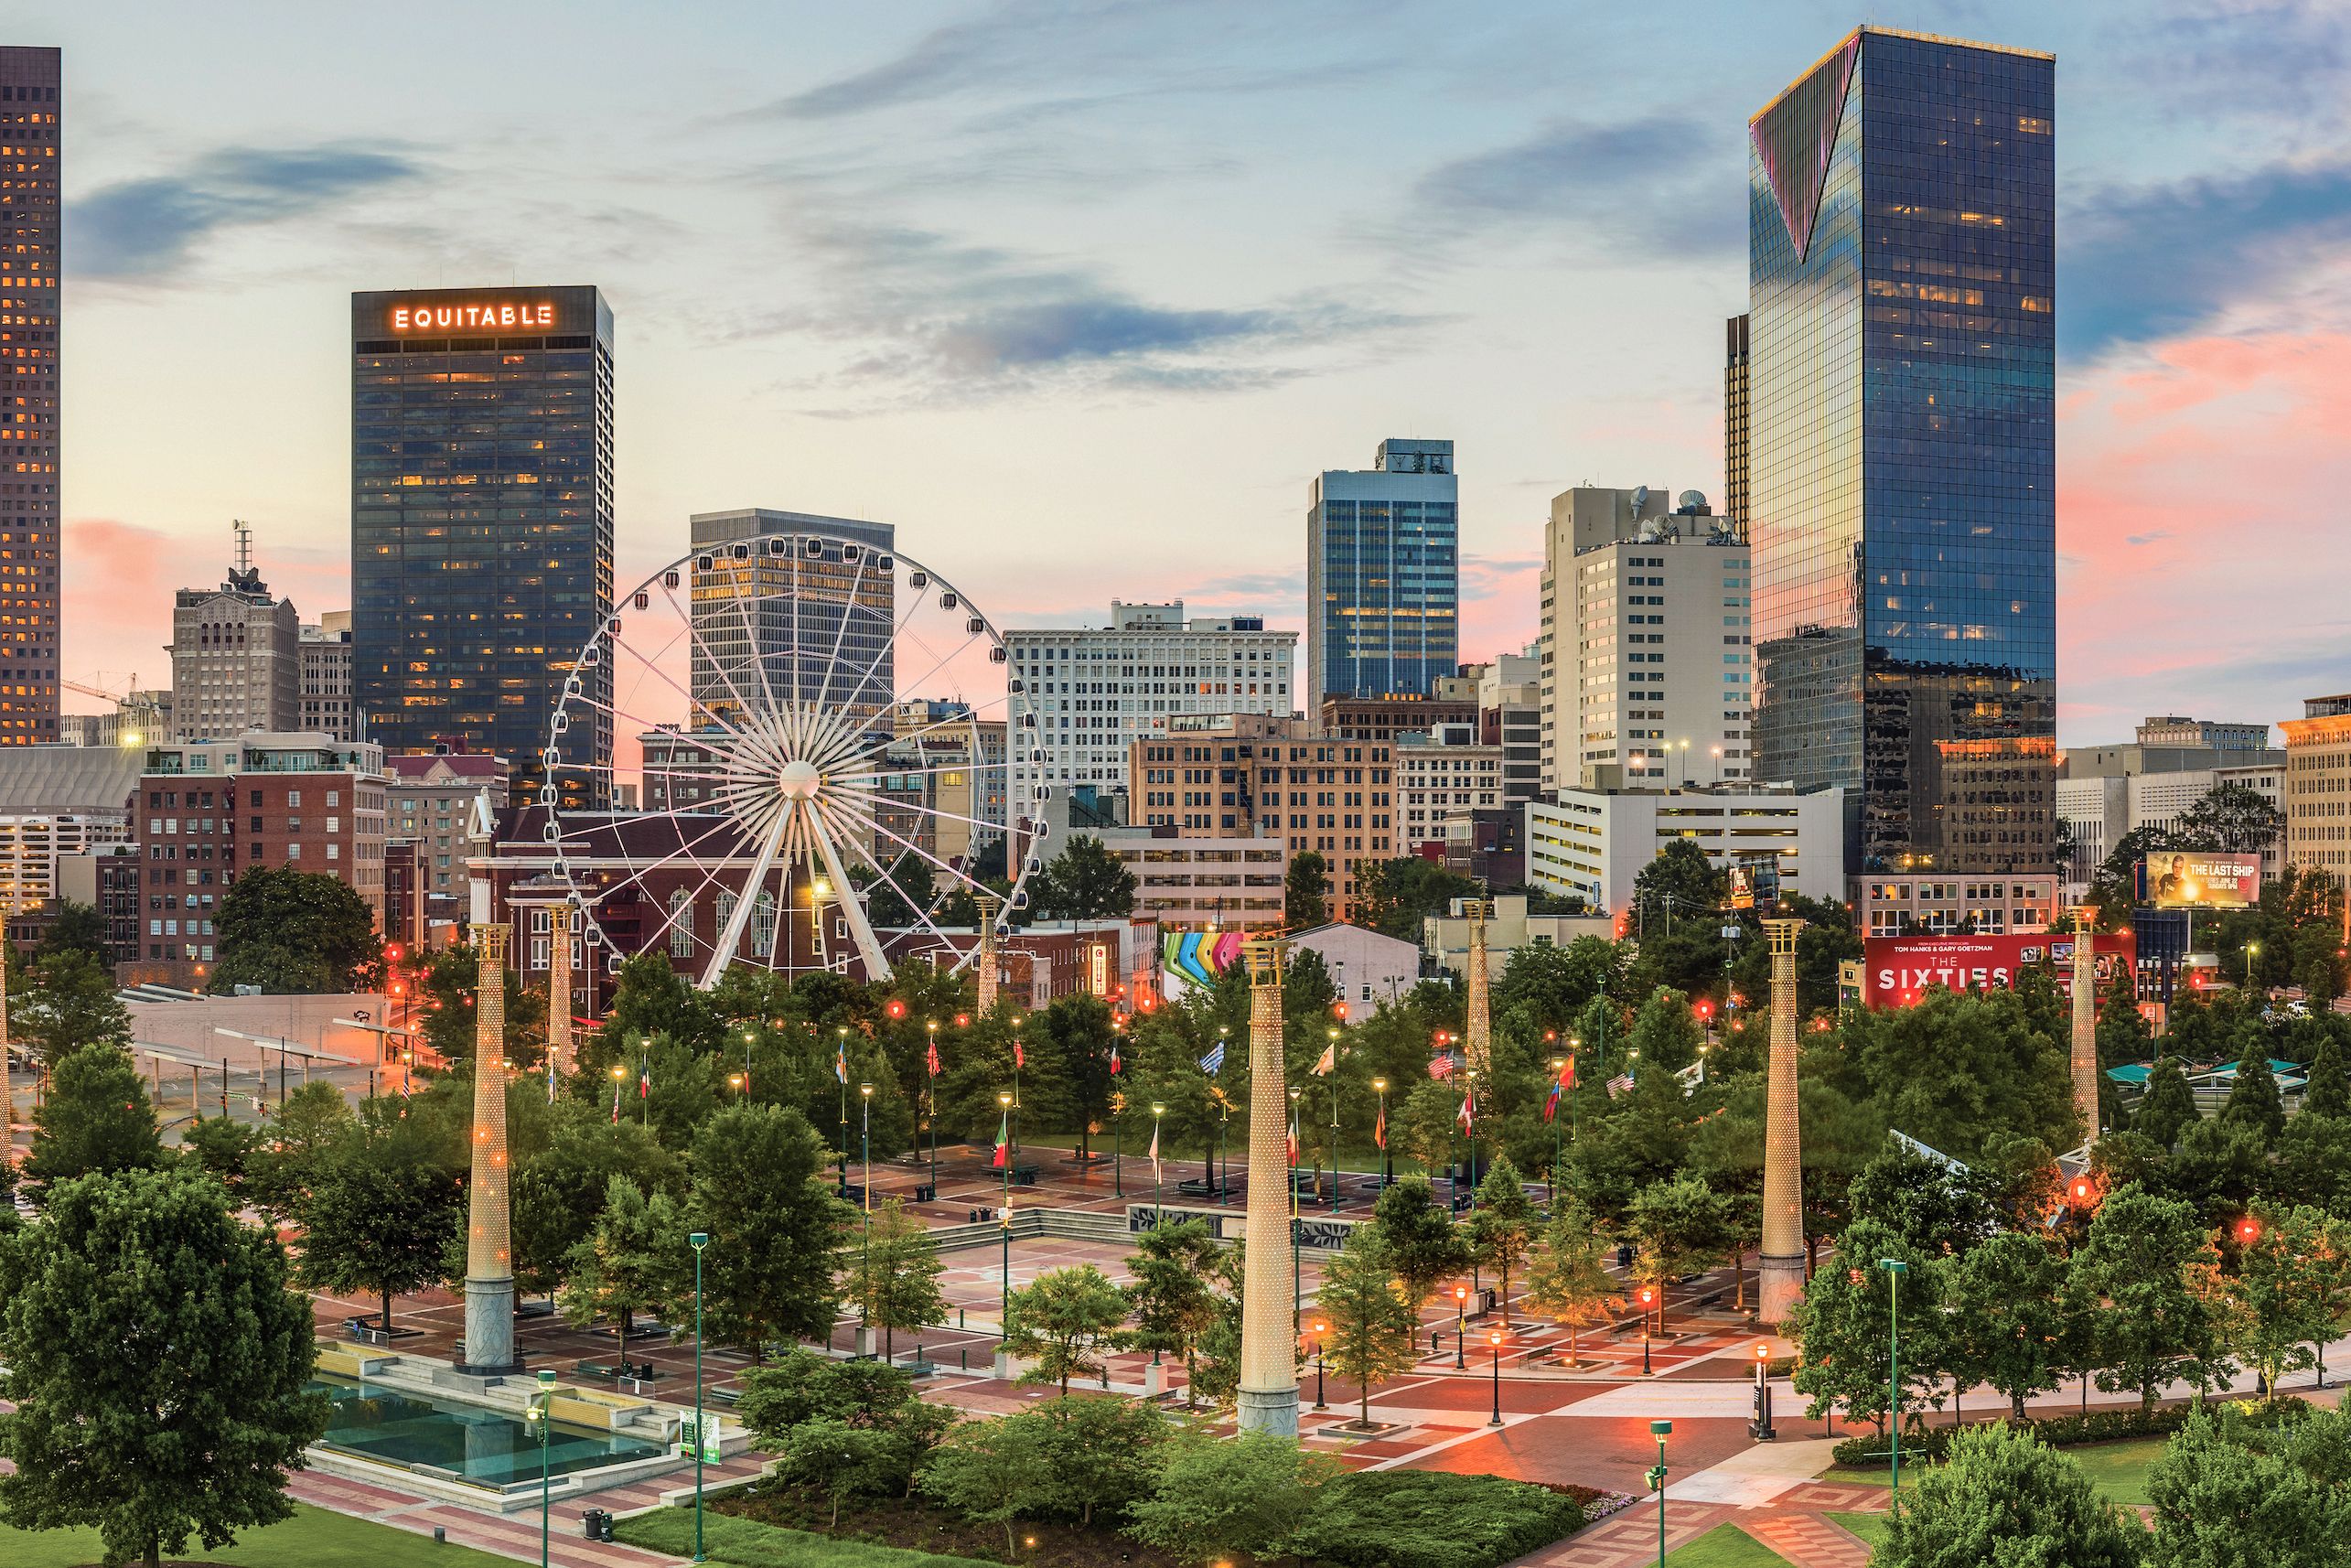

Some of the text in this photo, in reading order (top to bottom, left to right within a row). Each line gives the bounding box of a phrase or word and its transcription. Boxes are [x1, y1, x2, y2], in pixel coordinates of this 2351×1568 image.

[395, 306, 552, 328] EQUITABLE
[2190, 864, 2255, 876] THE LAST SHIP
[1930, 956, 1958, 967] THE
[1878, 967, 2009, 990] SIXTIES
